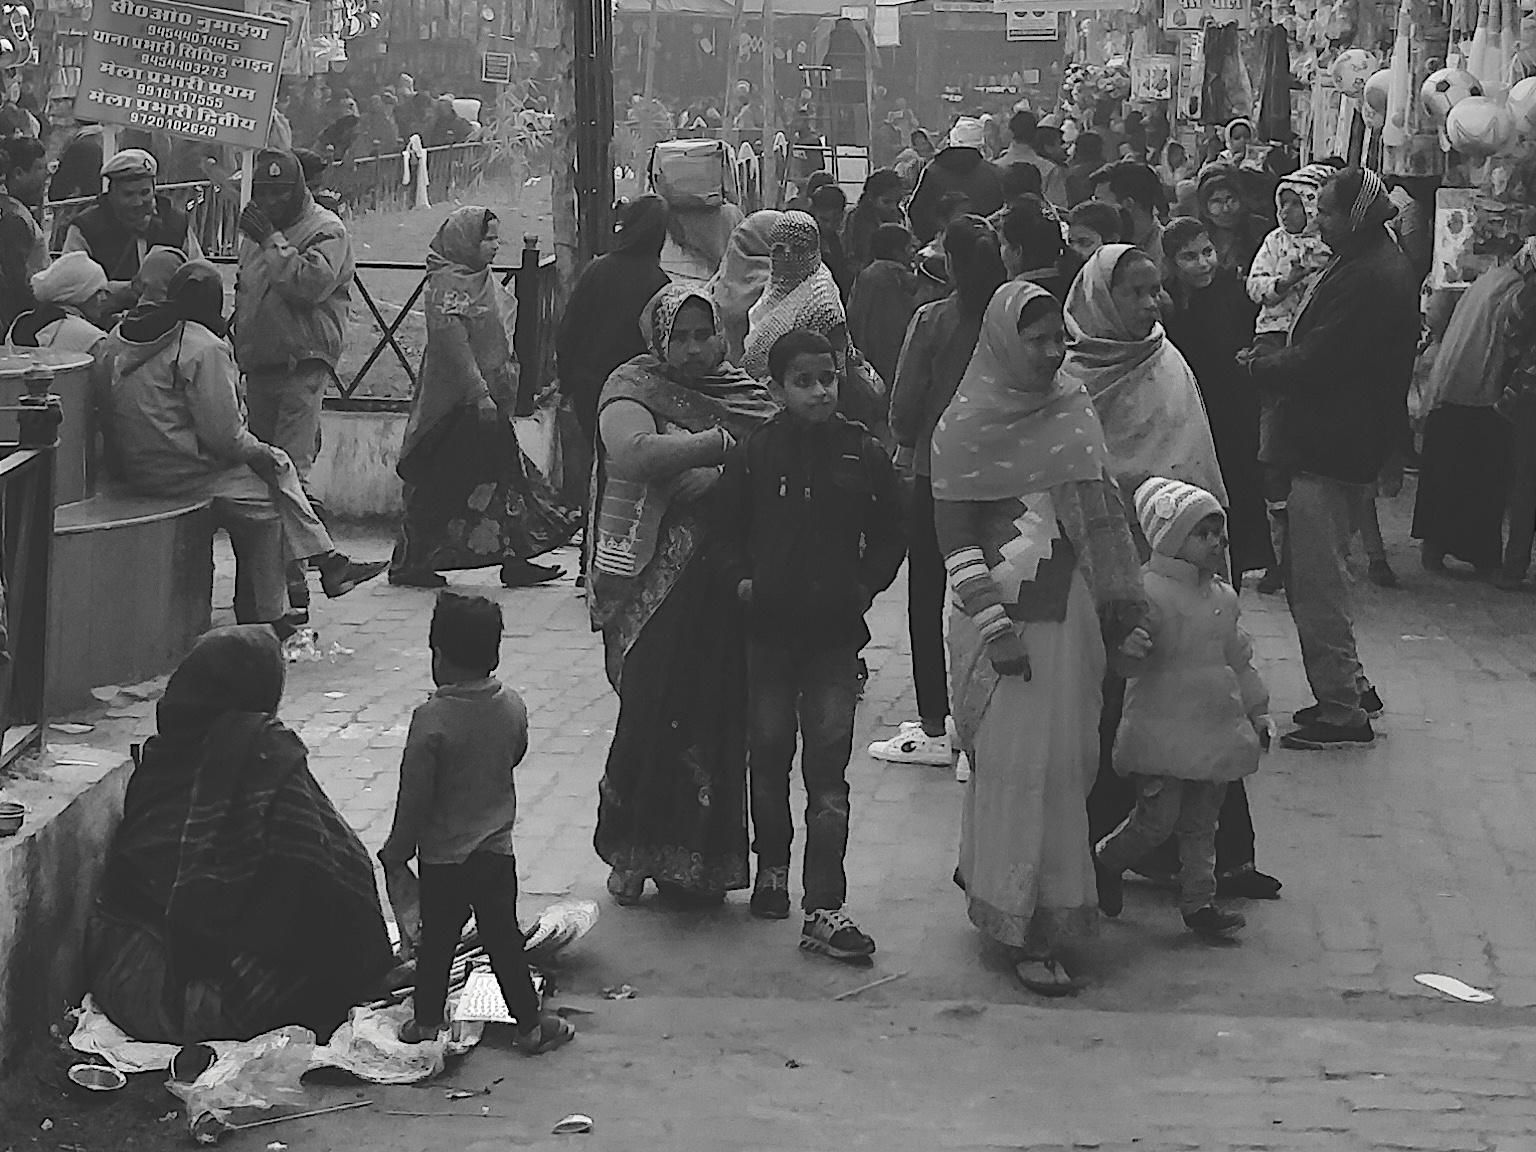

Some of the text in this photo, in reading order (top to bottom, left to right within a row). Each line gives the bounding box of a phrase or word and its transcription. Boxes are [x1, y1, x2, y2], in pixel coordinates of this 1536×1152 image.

[92, 29, 275, 74] थाना प्रभारी सिविल लाइन
[147, 24, 241, 52] 9454401445
[141, 53, 228, 79] 9454403273
[99, 61, 257, 102] मेला प्रभारी प्रथम
[89, 89, 132, 109] मेला
[136, 97, 195, 120] प्रभारी
[130, 112, 217, 138] 9720102628
